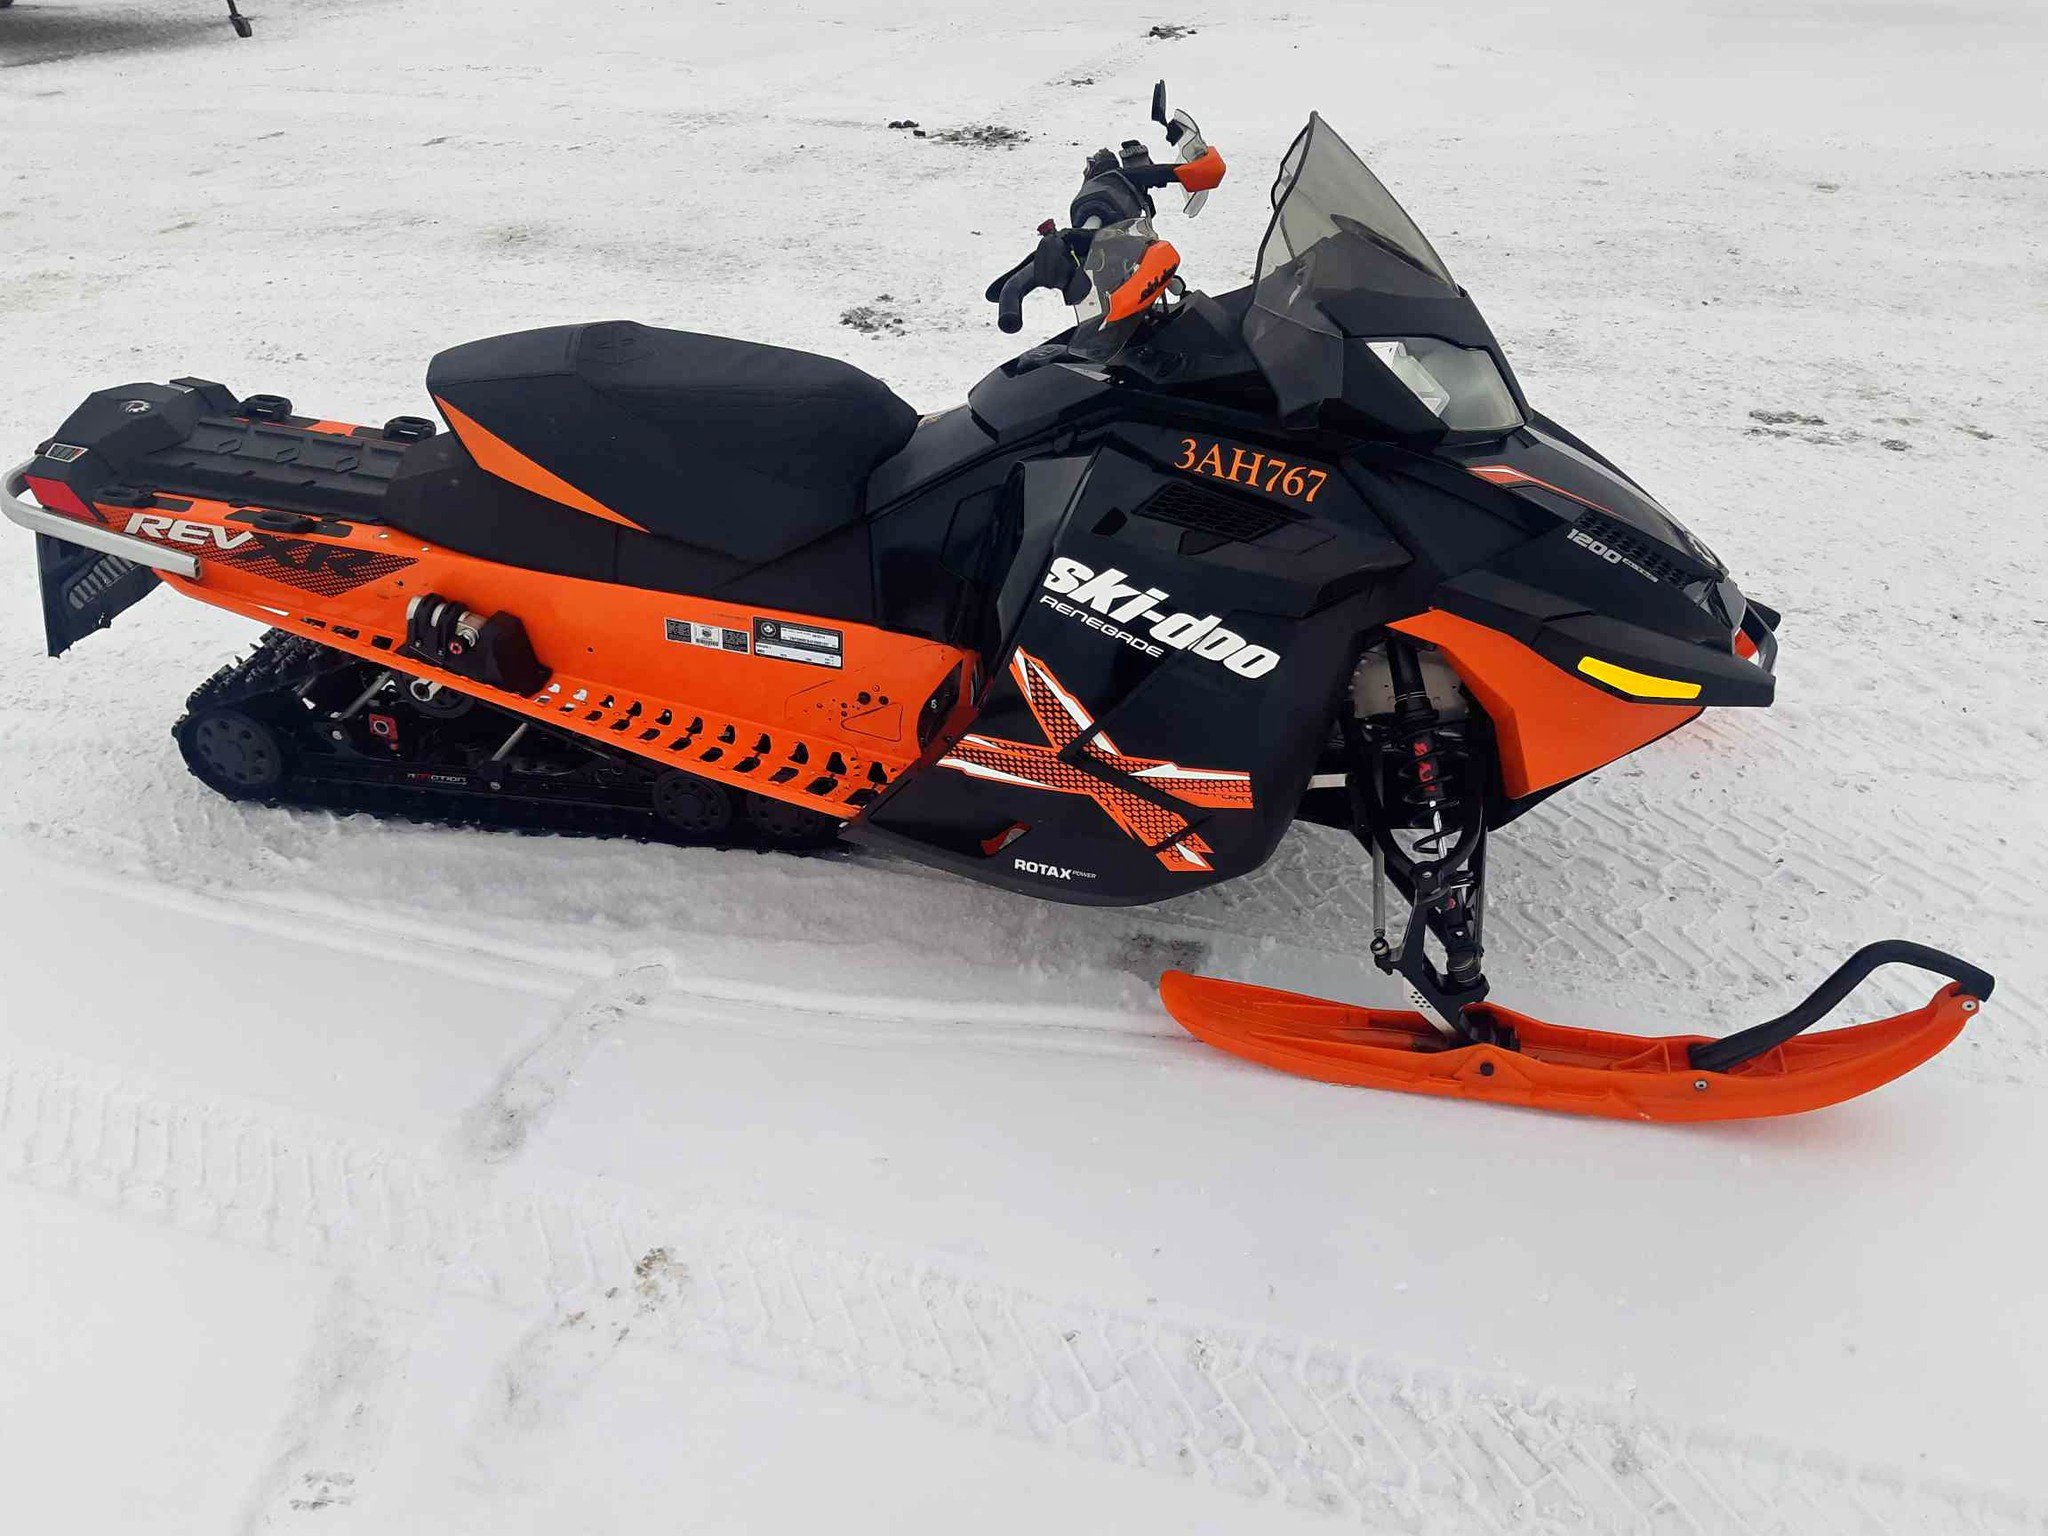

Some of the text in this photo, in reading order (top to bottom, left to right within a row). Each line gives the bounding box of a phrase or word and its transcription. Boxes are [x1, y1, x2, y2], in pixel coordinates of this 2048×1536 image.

[1174, 438, 1328, 503] 3AH767
[124, 512, 377, 578] REV XR
[1566, 528, 1623, 565] 1200
[1040, 594, 1165, 658] RENEGADE
[1043, 556, 1281, 679] ski-doo
[1014, 858, 1072, 880] ROTAX
